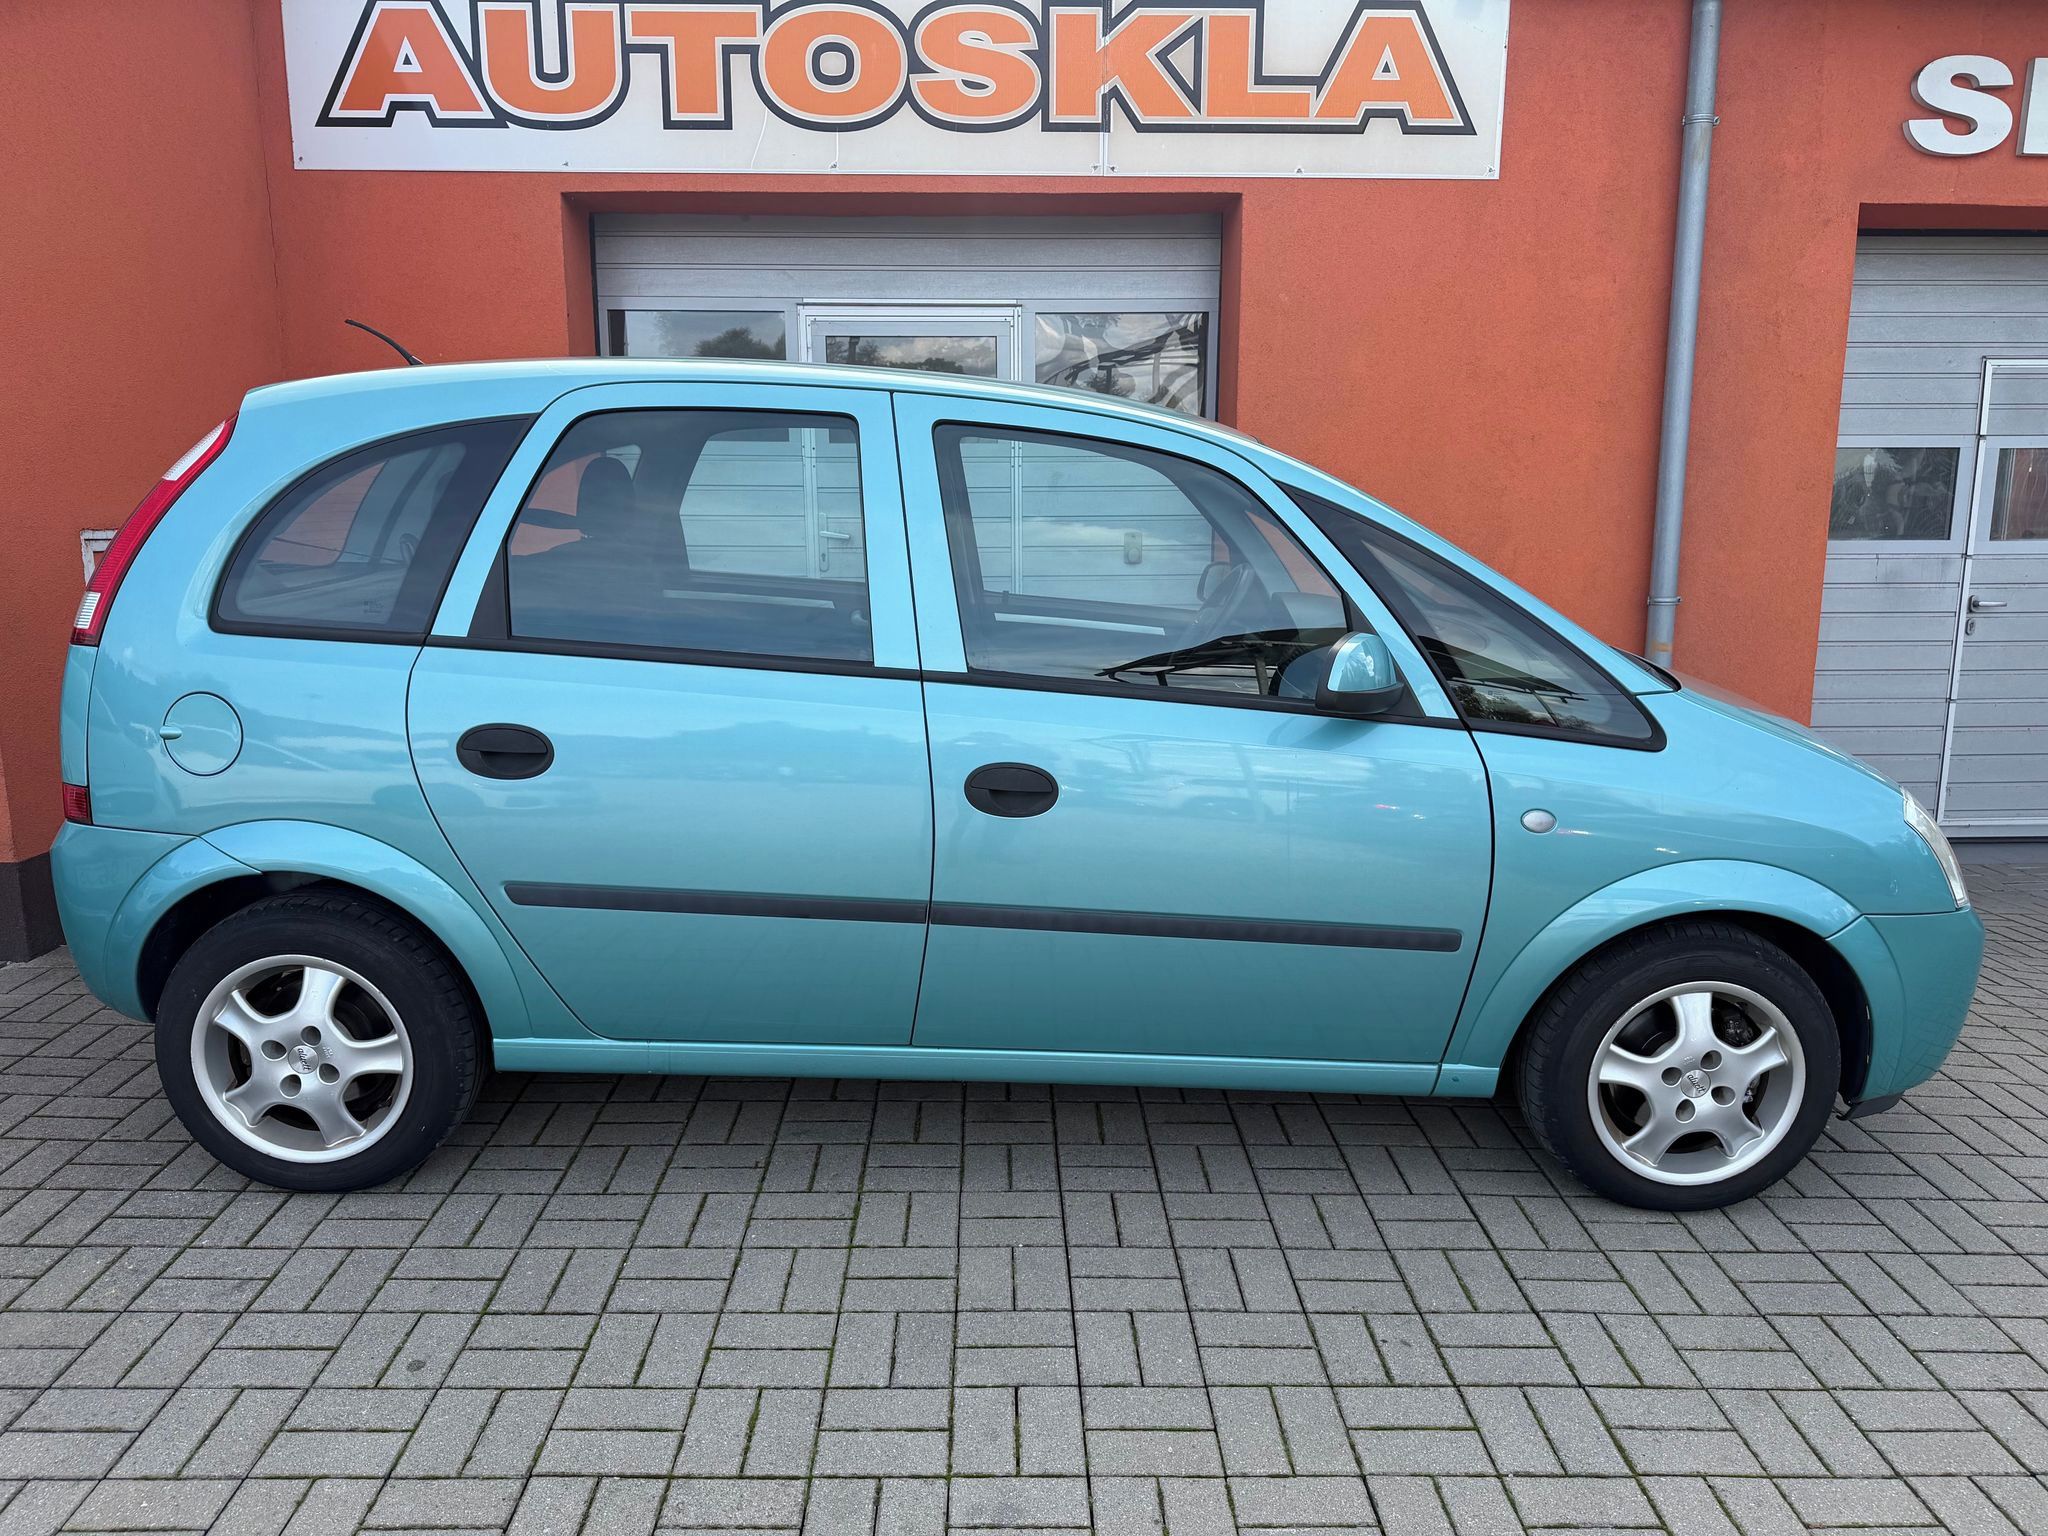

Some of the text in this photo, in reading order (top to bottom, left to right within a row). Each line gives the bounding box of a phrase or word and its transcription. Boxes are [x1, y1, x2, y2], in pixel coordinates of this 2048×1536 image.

[315, 0, 1477, 135] AUTOSKLA
[1903, 55, 2048, 158] S
[1687, 1074, 1707, 1093] aluett
